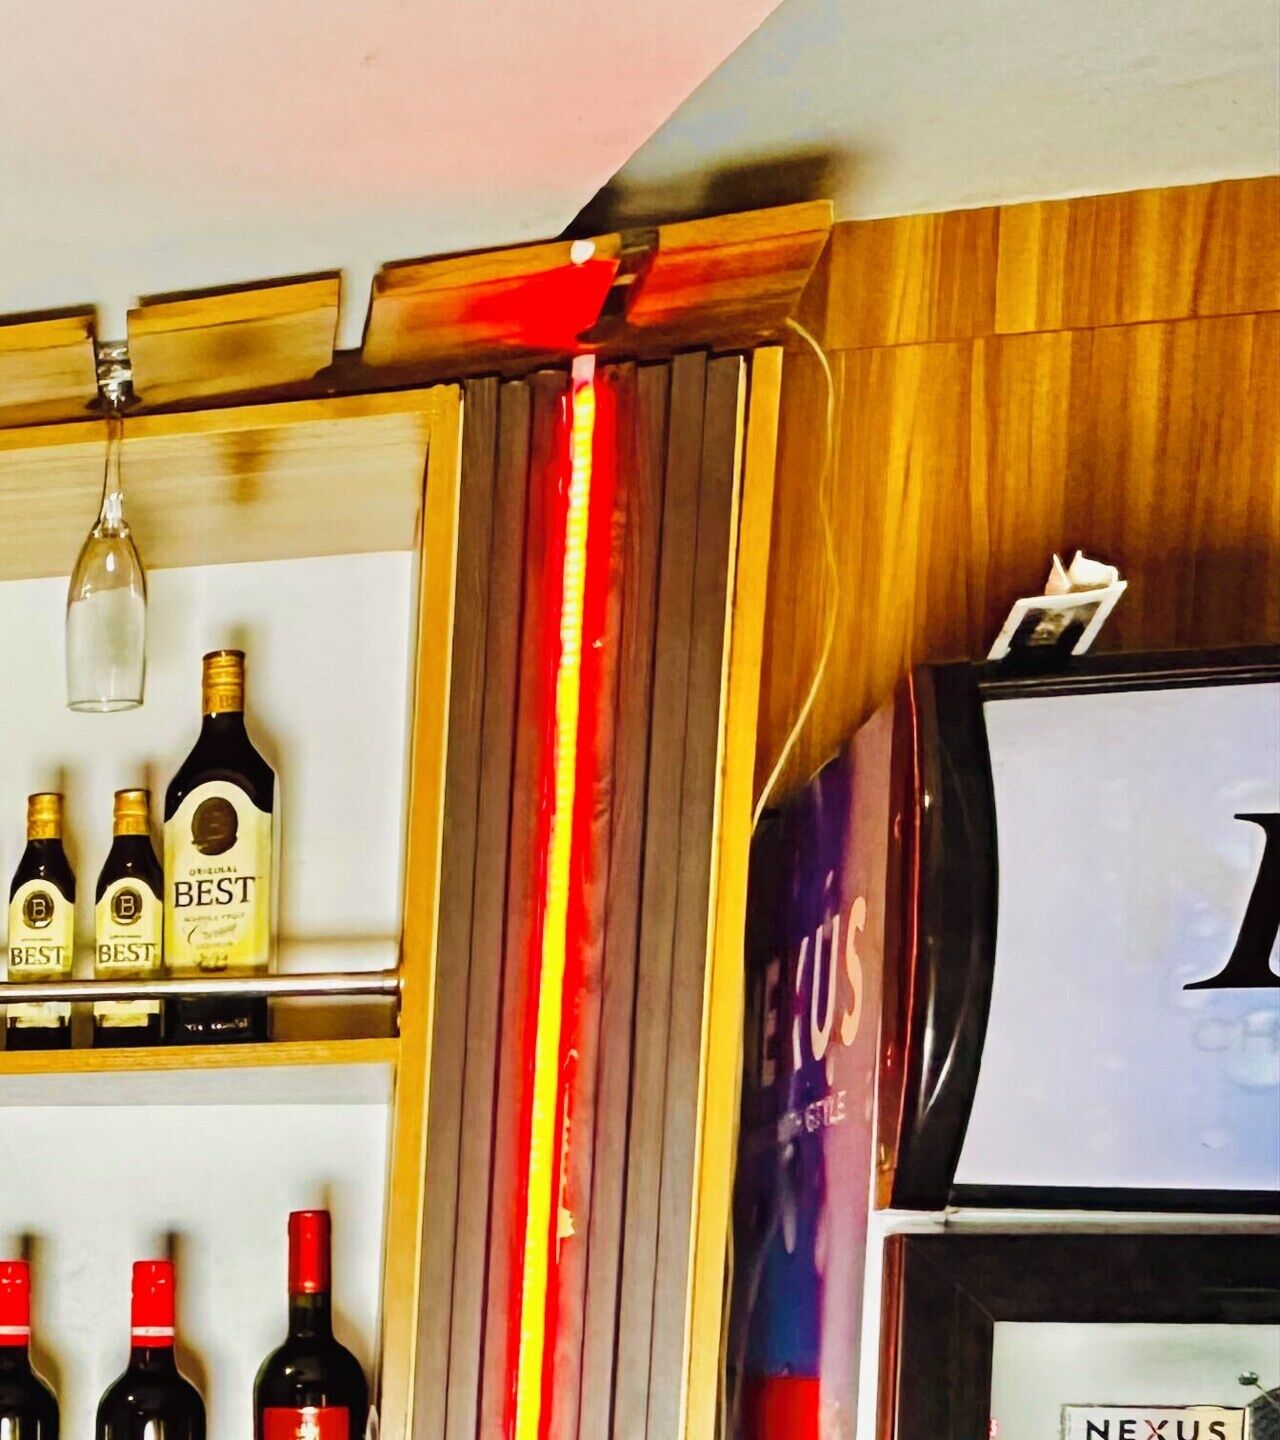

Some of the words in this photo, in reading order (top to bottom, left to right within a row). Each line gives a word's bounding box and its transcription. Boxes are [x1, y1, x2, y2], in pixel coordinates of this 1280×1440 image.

[174, 876, 256, 908] BEST
[11, 946, 65, 966] BEST
[98, 943, 156, 964] BEST
